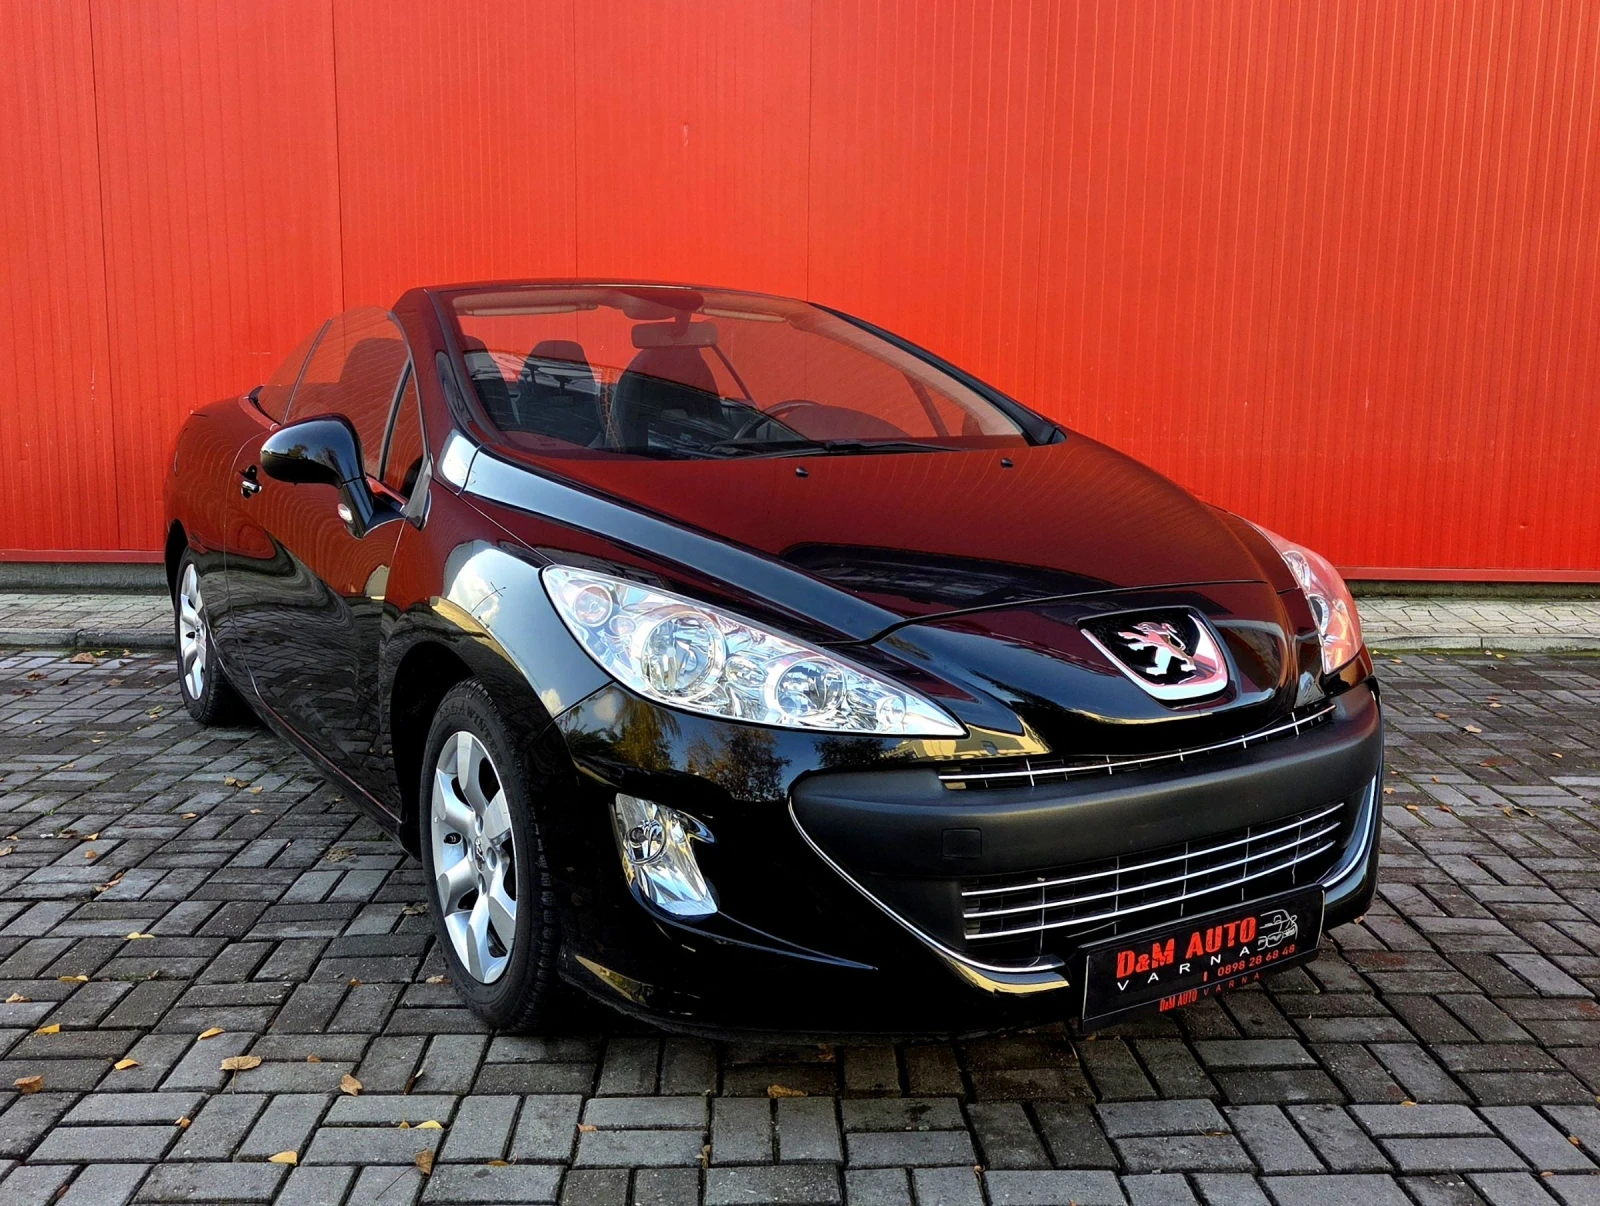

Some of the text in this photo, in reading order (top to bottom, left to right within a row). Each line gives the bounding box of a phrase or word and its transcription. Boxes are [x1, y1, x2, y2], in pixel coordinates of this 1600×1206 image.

[1116, 917, 1256, 978] D&M AUTO
[1217, 944, 1295, 976] 0898 28 68 48
[1117, 947, 1250, 990] VARNA
[1159, 972, 1260, 1012] D&M AUTO VARNA
